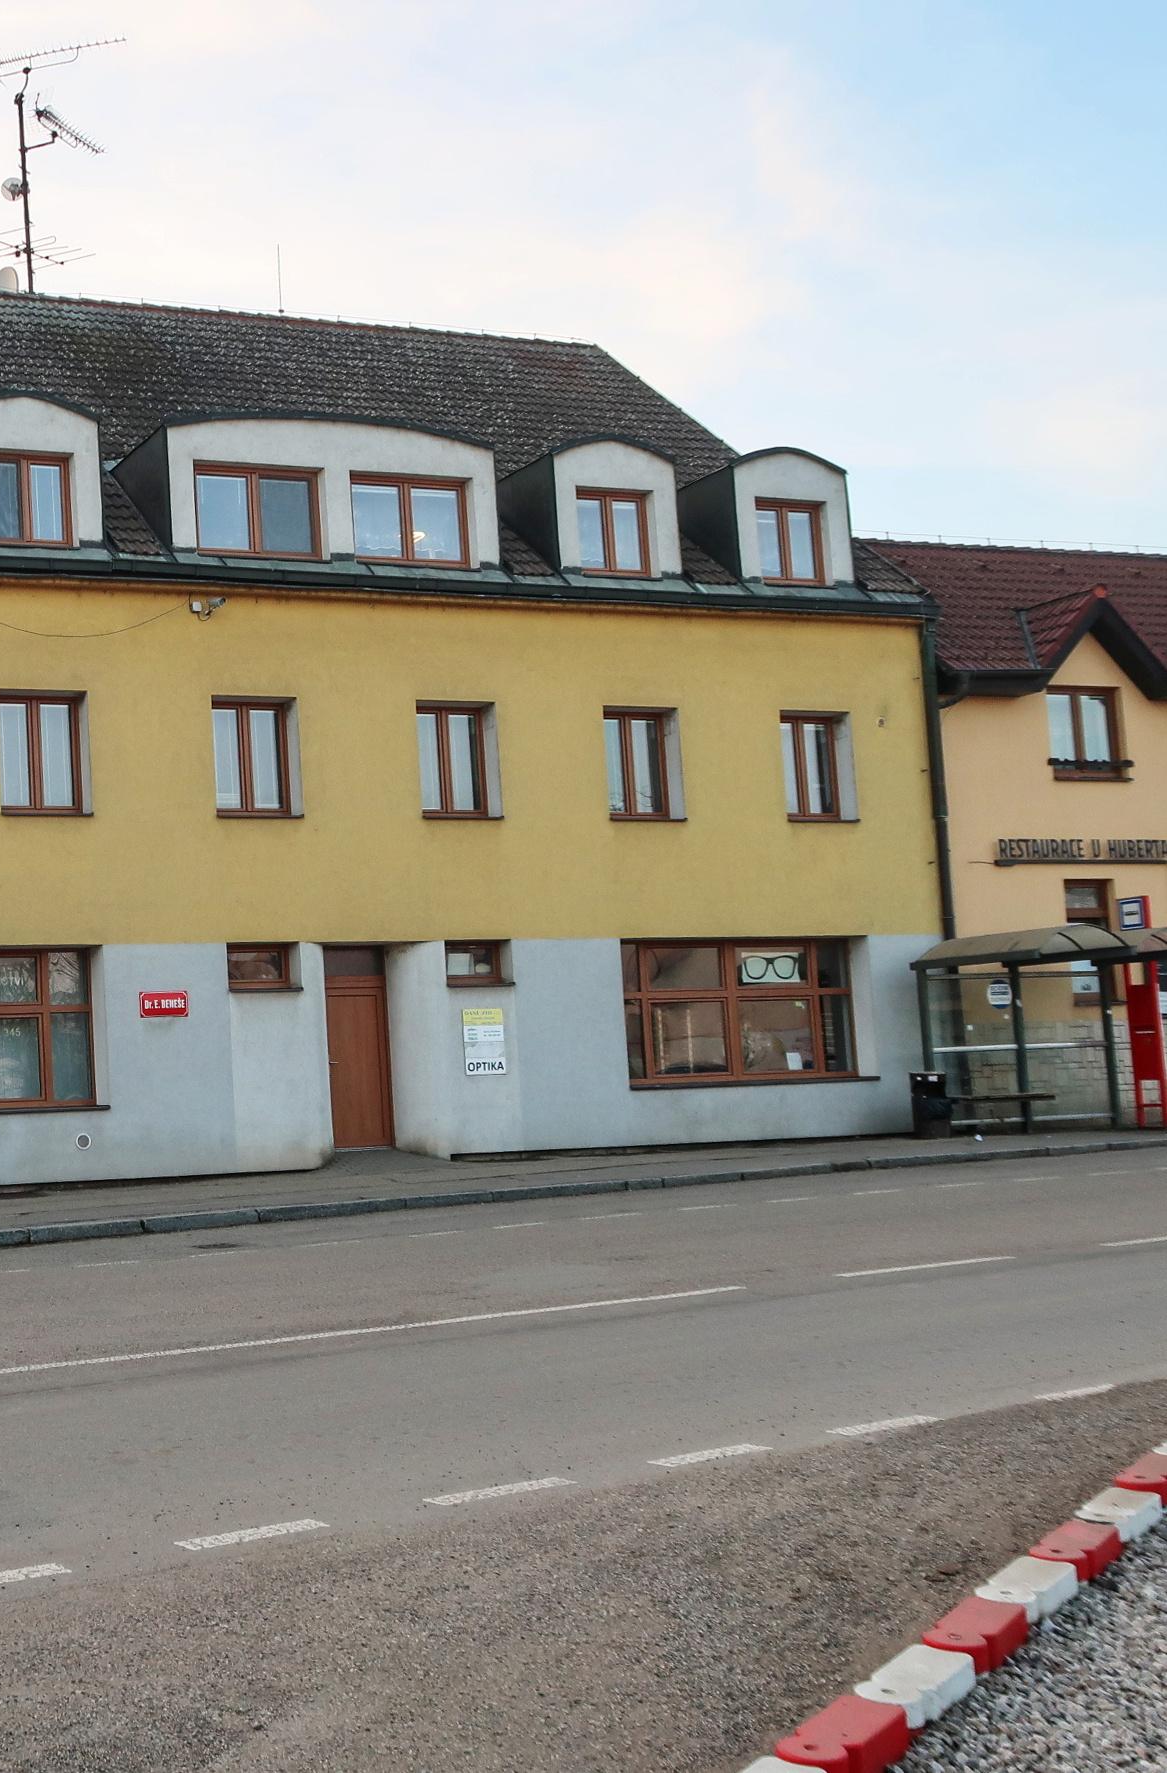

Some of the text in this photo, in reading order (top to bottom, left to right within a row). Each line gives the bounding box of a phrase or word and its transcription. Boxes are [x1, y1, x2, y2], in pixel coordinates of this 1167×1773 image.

[997, 838, 1085, 858] RESTAURACE
[1090, 838, 1102, 858] U
[144, 1000, 153, 1009] Dr.
[154, 999, 161, 1009] E.
[467, 1061, 504, 1072] OPTIKA
